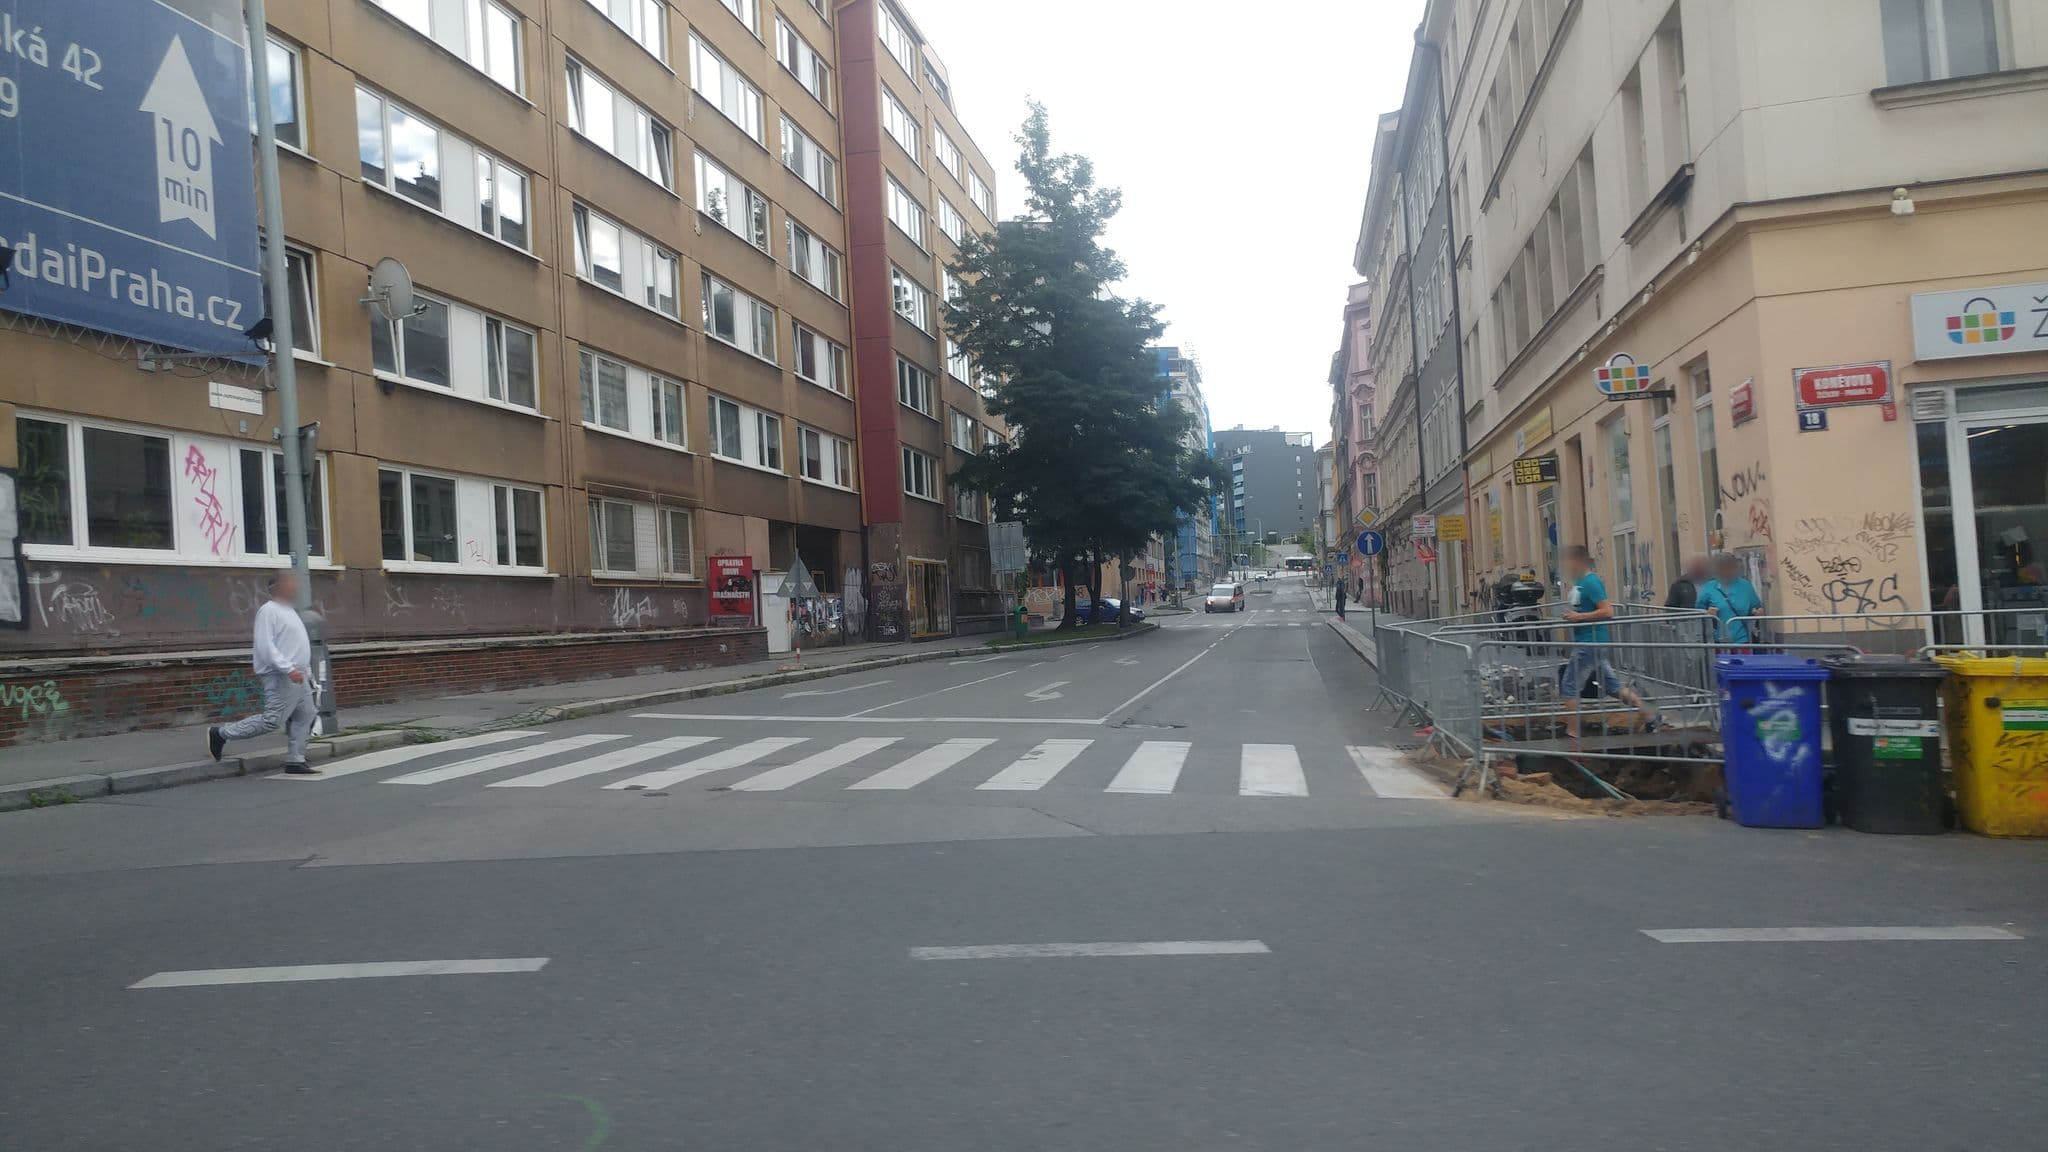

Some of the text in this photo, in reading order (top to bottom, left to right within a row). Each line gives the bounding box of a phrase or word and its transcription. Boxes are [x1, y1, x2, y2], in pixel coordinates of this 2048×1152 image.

[0, 12, 103, 90] ká 42
[0, 77, 18, 117] 9
[162, 117, 200, 171] 10
[164, 177, 208, 212] min
[0, 231, 244, 331] daiPraha.cz
[1805, 412, 1820, 425] 18
